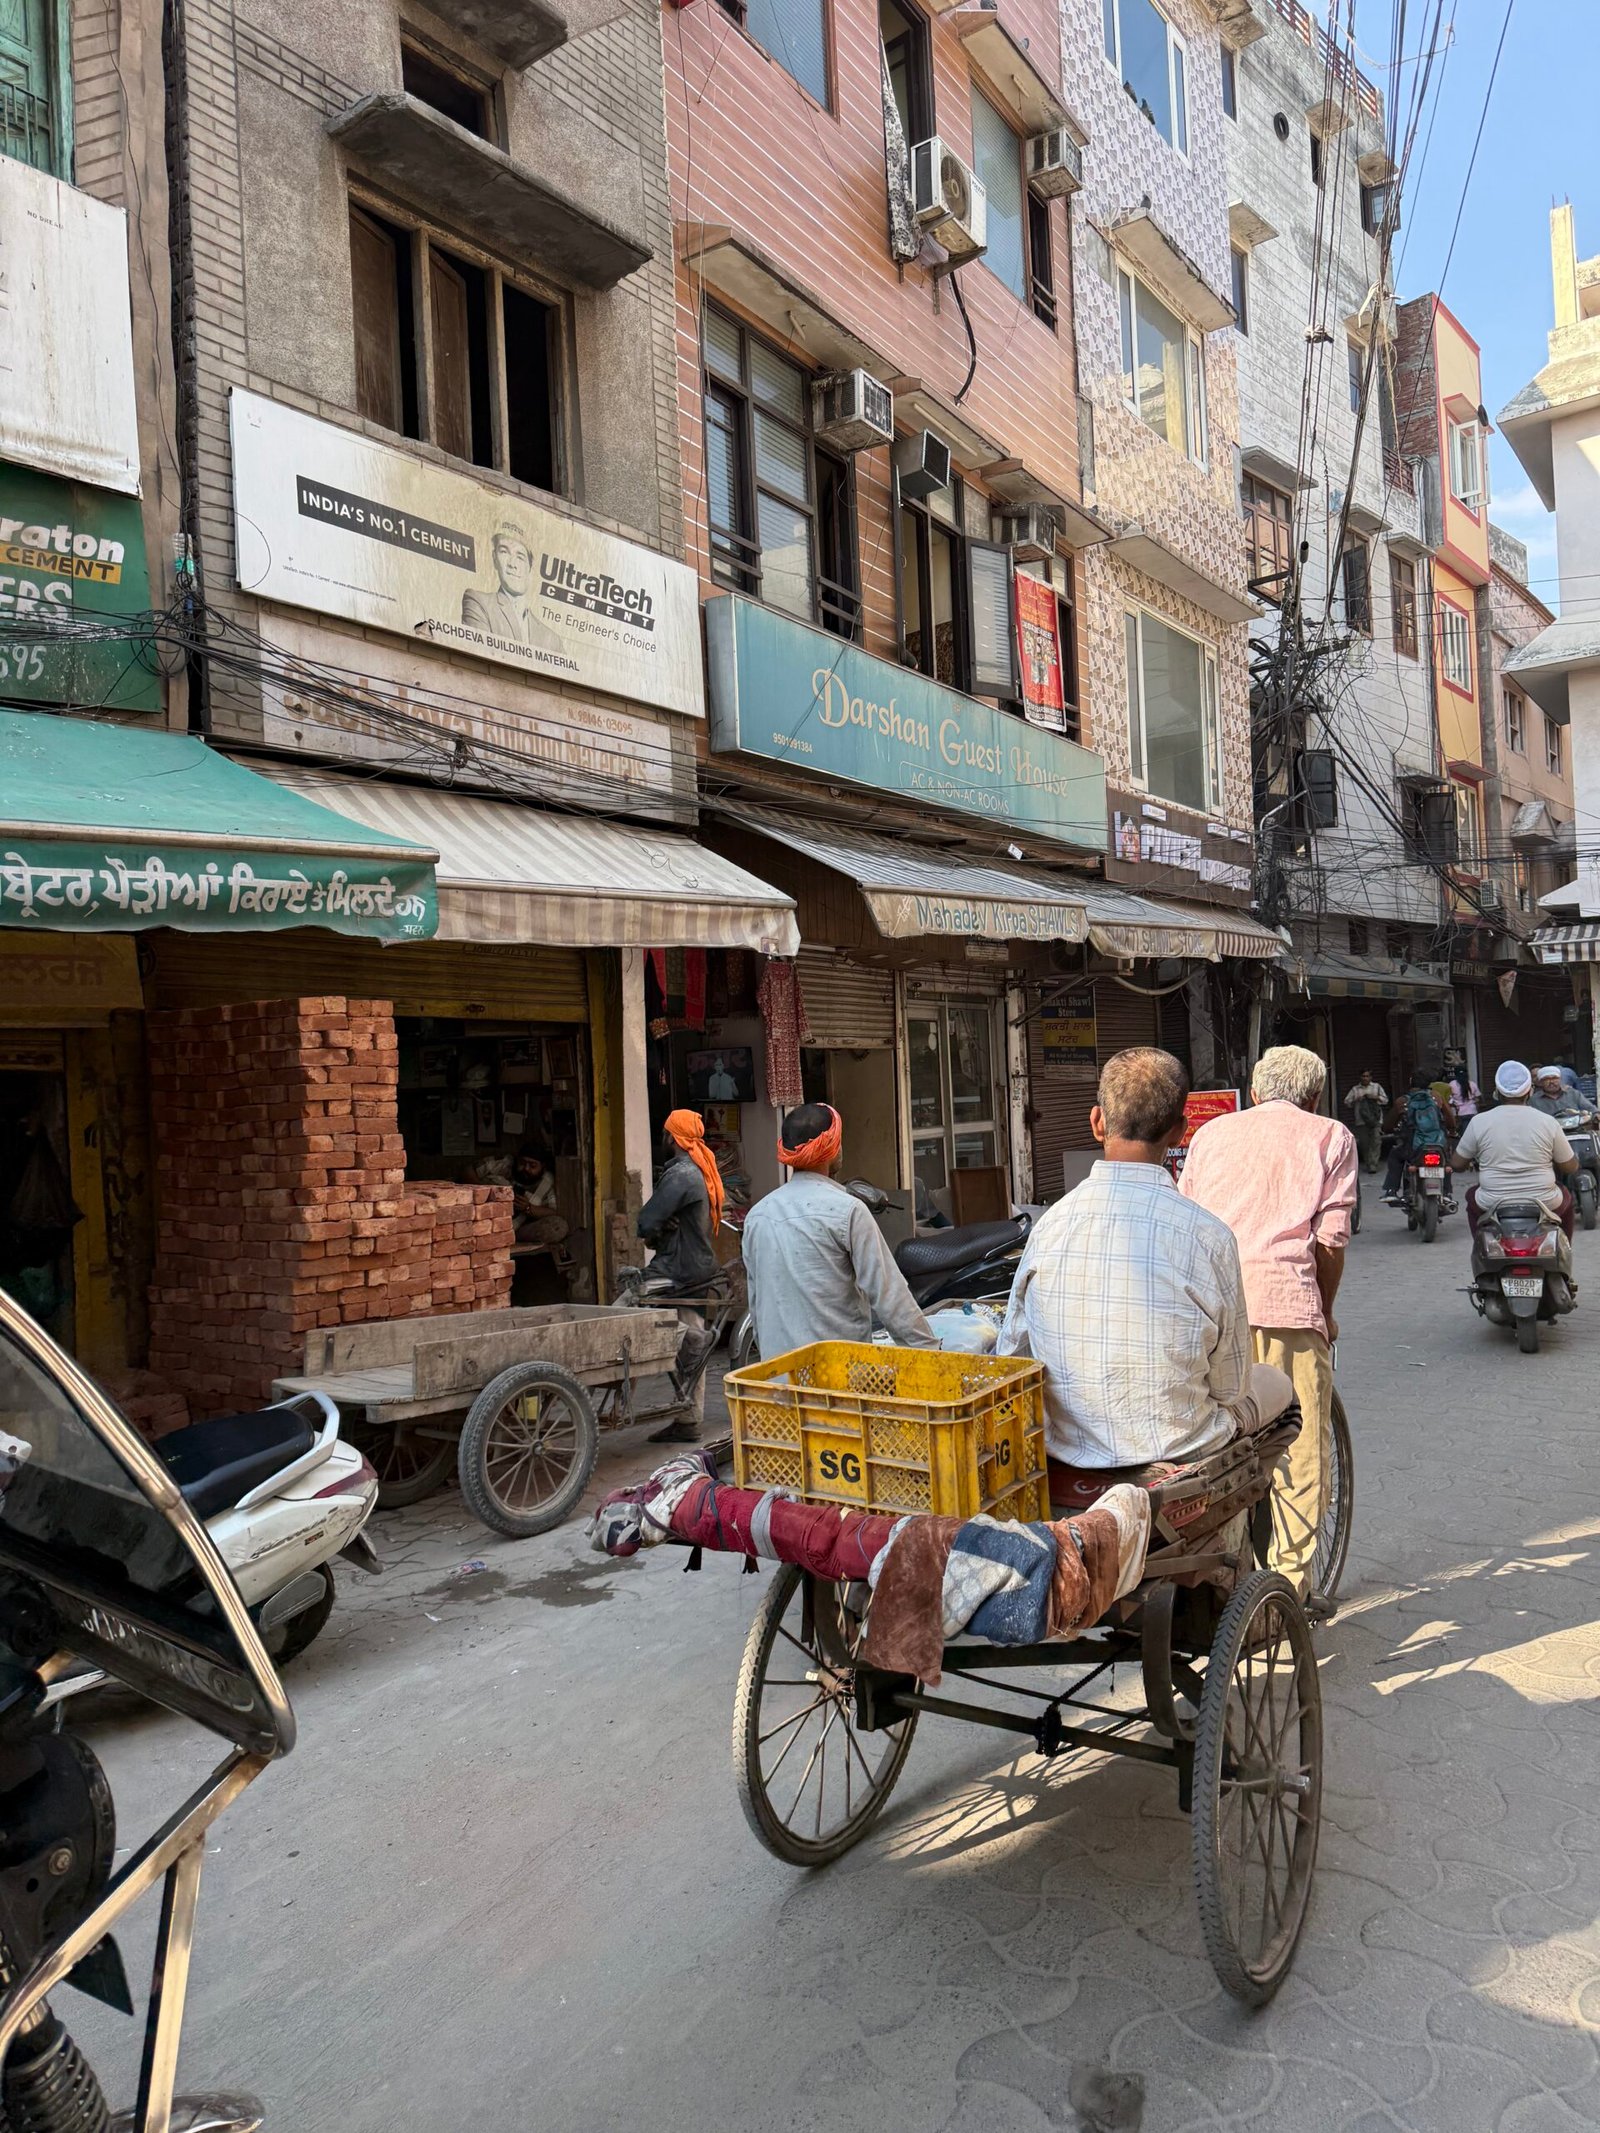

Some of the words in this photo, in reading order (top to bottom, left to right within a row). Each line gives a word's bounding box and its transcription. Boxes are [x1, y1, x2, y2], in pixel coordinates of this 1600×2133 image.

[302, 489, 366, 524] INDIA'S
[370, 515, 407, 538] NO.1
[410, 527, 471, 560] CEMENT
[6, 546, 114, 581] CEMENT
[540, 553, 654, 616] UltraTech
[541, 605, 562, 623] The
[565, 613, 620, 641] Engineer's
[622, 632, 657, 653] Choice
[546, 585, 651, 629] CEMENT
[428, 618, 484, 645] SACHDEVA
[486, 636, 533, 659] BUILDING
[534, 650, 580, 672] MATERIAL
[811, 667, 931, 751] Darshan
[939, 718, 1004, 776] Guest
[1009, 746, 1070, 798] House
[911, 772, 925, 790] AC
[927, 778, 935, 793] &
[937, 779, 978, 806] NON-AC
[978, 791, 1010, 815] ROOMS
[228, 862, 313, 914] ਕਿਰਾਏ
[326, 870, 396, 917] ਮਿਲਦੇ
[991, 901, 1027, 936] Kirpa
[1028, 904, 1080, 938] SHAWLS
[819, 1449, 862, 1484] SG
